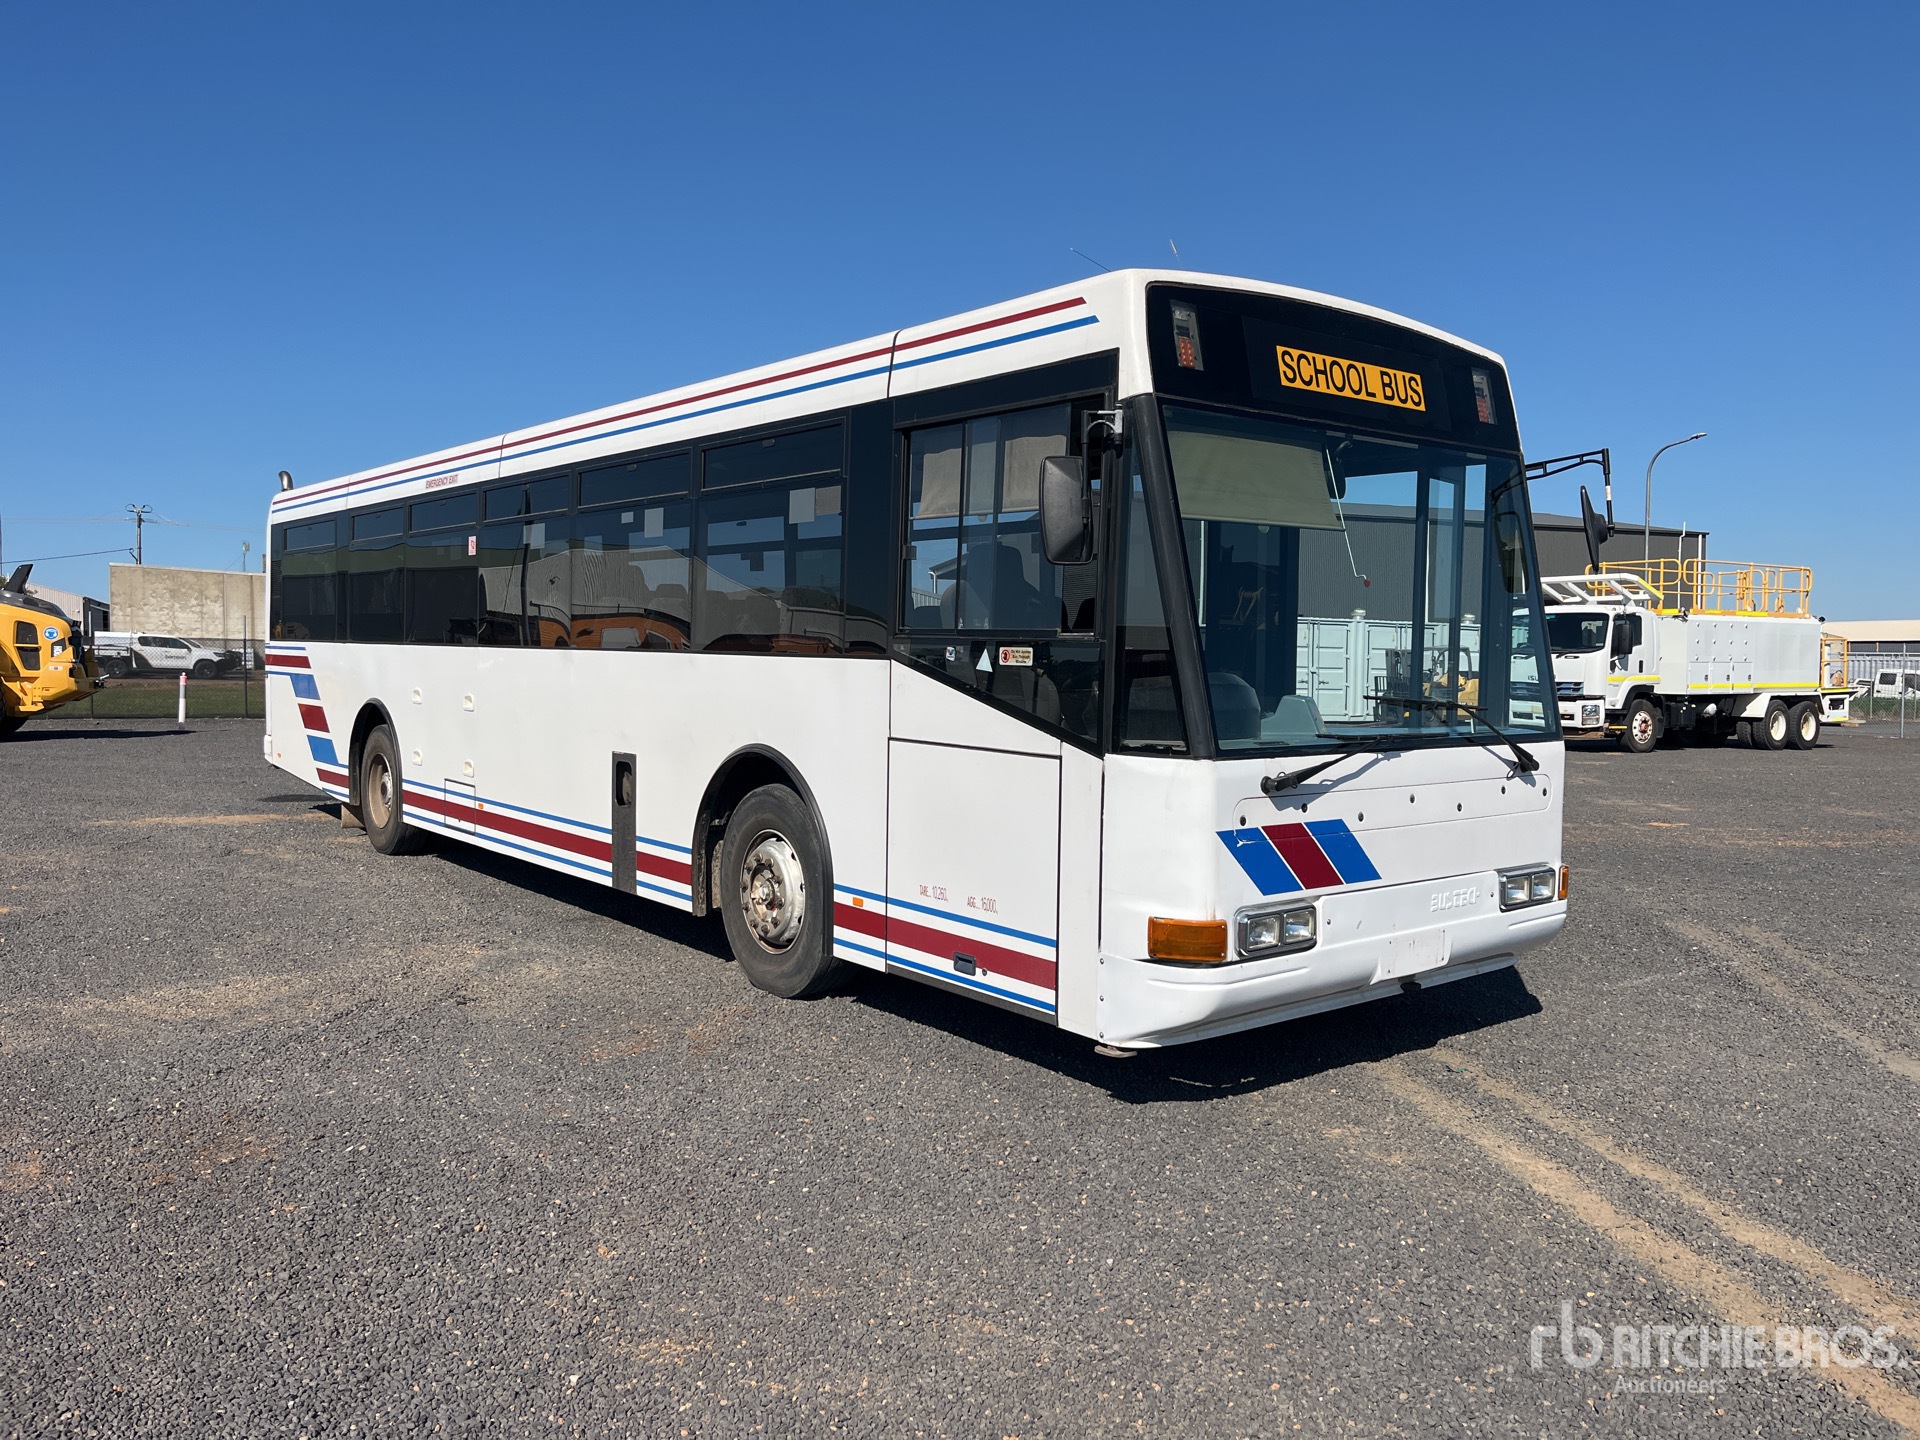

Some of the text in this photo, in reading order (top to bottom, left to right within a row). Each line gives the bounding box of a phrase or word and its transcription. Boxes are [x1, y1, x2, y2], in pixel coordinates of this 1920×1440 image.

[1281, 350, 1422, 407] SCHOOL BUS
[425, 474, 459, 489] EMERGENCY EXIT
